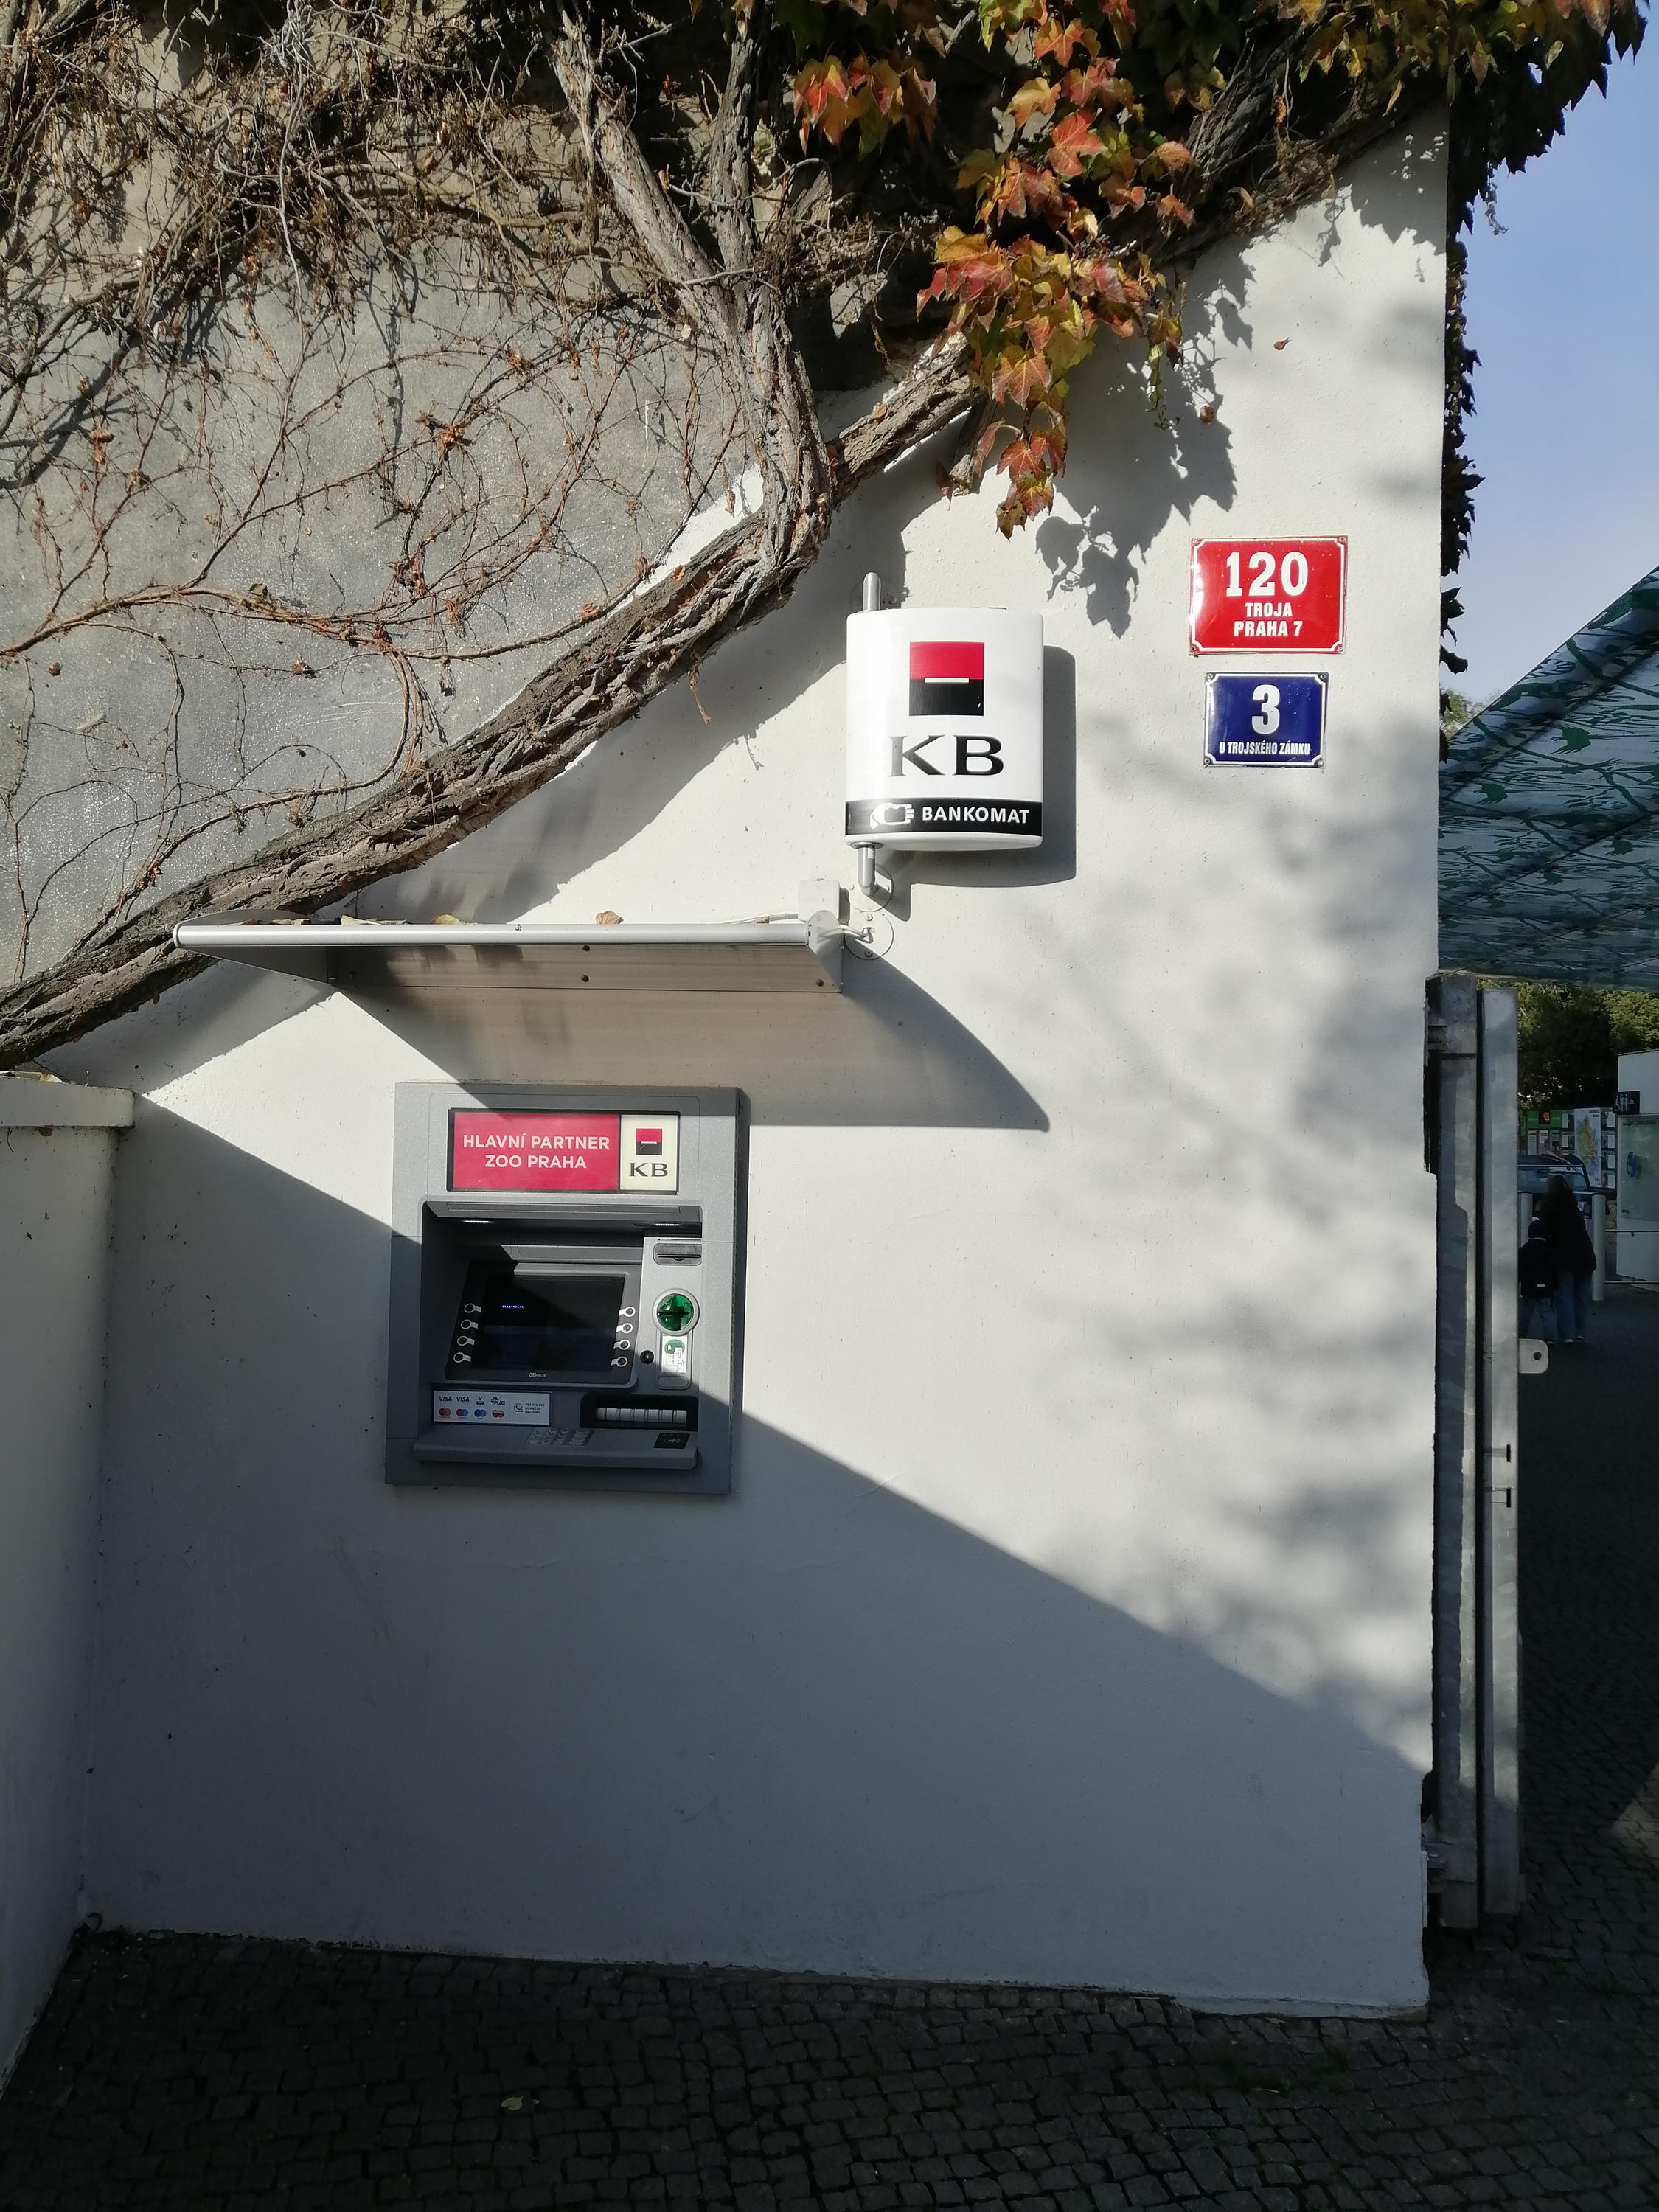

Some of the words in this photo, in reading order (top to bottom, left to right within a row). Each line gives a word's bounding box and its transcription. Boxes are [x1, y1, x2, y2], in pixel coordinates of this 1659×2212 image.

[1226, 552, 1308, 597] 120
[1245, 602, 1293, 617] TROJA
[1234, 620, 1288, 636] PRAHA
[1293, 620, 1303, 636] 7
[1251, 684, 1280, 734] 3
[888, 734, 1004, 776] KB
[1219, 742, 1225, 754] U
[1227, 740, 1278, 754] TROJSKÉHO
[1279, 740, 1311, 755] ZÁMKU
[922, 806, 1029, 824] BANKOMAT
[463, 1133, 526, 1149] HLAVNÍ
[531, 1135, 610, 1150] PARTNER
[485, 1155, 521, 1168] ZOO
[527, 1155, 587, 1169] PRAHA
[630, 1162, 668, 1177] KB
